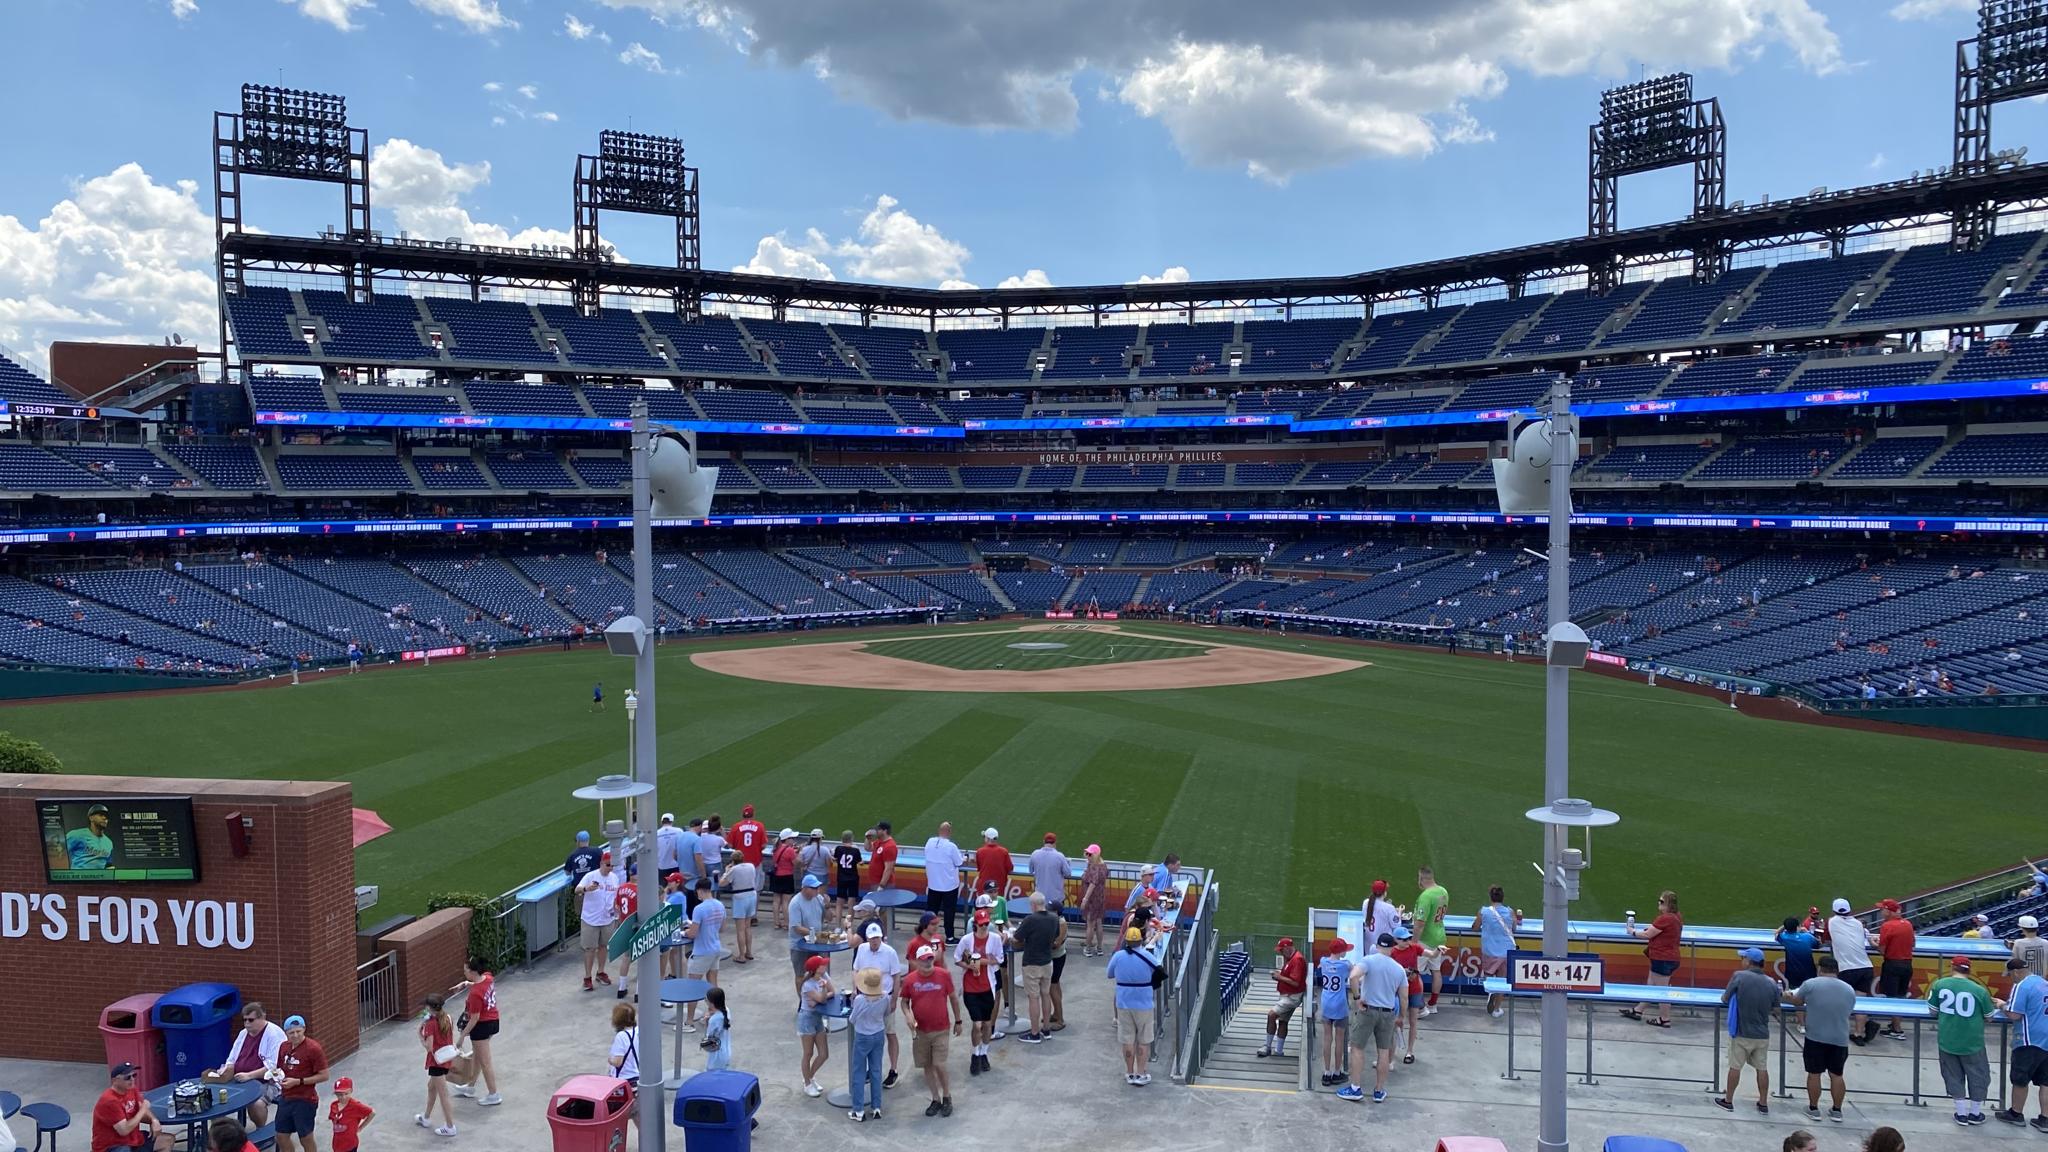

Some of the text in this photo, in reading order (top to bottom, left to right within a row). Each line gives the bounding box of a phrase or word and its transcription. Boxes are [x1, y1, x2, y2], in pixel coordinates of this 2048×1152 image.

[16, 406, 44, 414] 12:32:53
[1040, 452, 1222, 463] HOME OF THE PHILADELPHIA PHILLIES
[840, 855, 854, 868] 42
[621, 898, 628, 914] 3
[77, 896, 160, 945] FOR
[168, 899, 254, 950] YOU
[632, 920, 669, 960] ASHBURN
[1522, 963, 1592, 981] 148 147
[1322, 974, 1341, 993] 28
[1938, 988, 1975, 1017] 20
